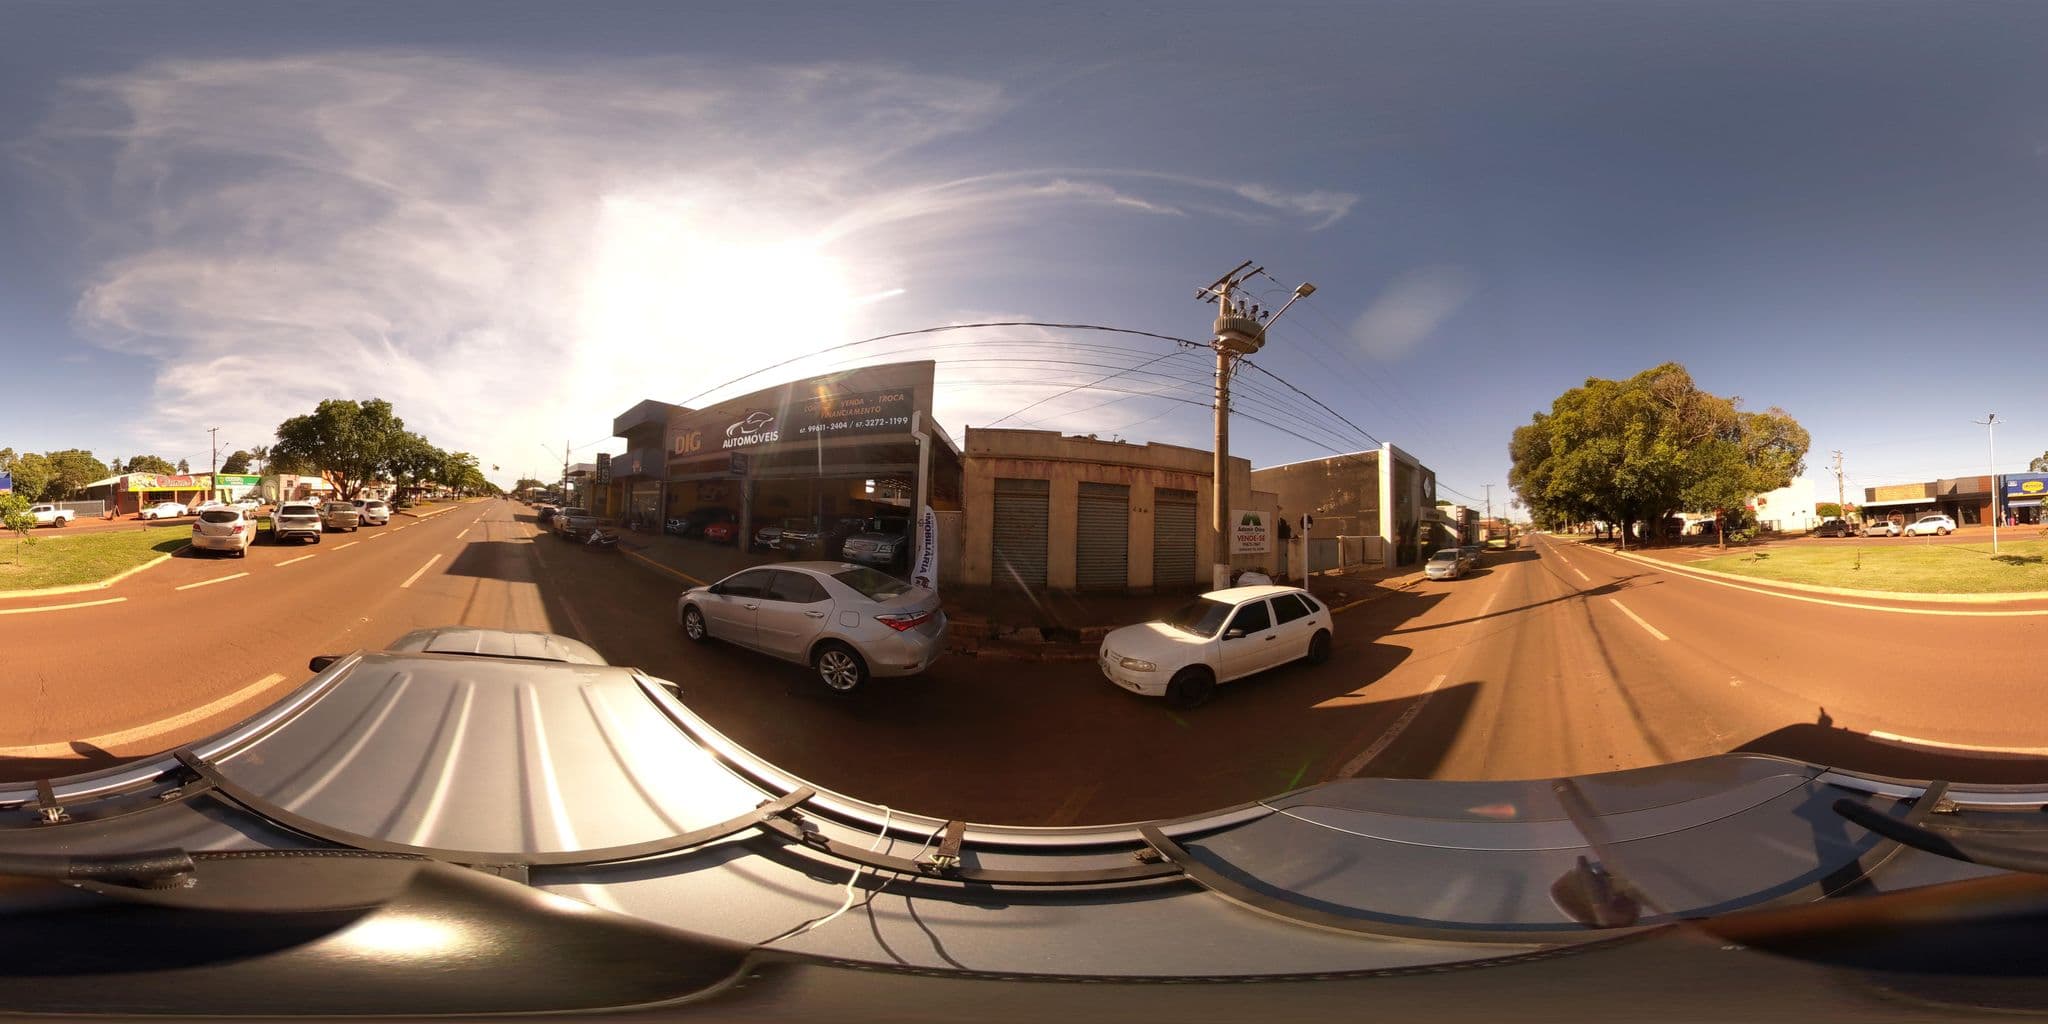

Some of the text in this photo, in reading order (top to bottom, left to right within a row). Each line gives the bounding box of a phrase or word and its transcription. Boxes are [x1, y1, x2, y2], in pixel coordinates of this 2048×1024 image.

[841, 399, 864, 408] VENDA
[879, 393, 904, 402] TROCA
[866, 416, 908, 427] 3272-1199
[675, 432, 702, 456] DIG
[722, 431, 779, 448] AUTOMÓVEIS
